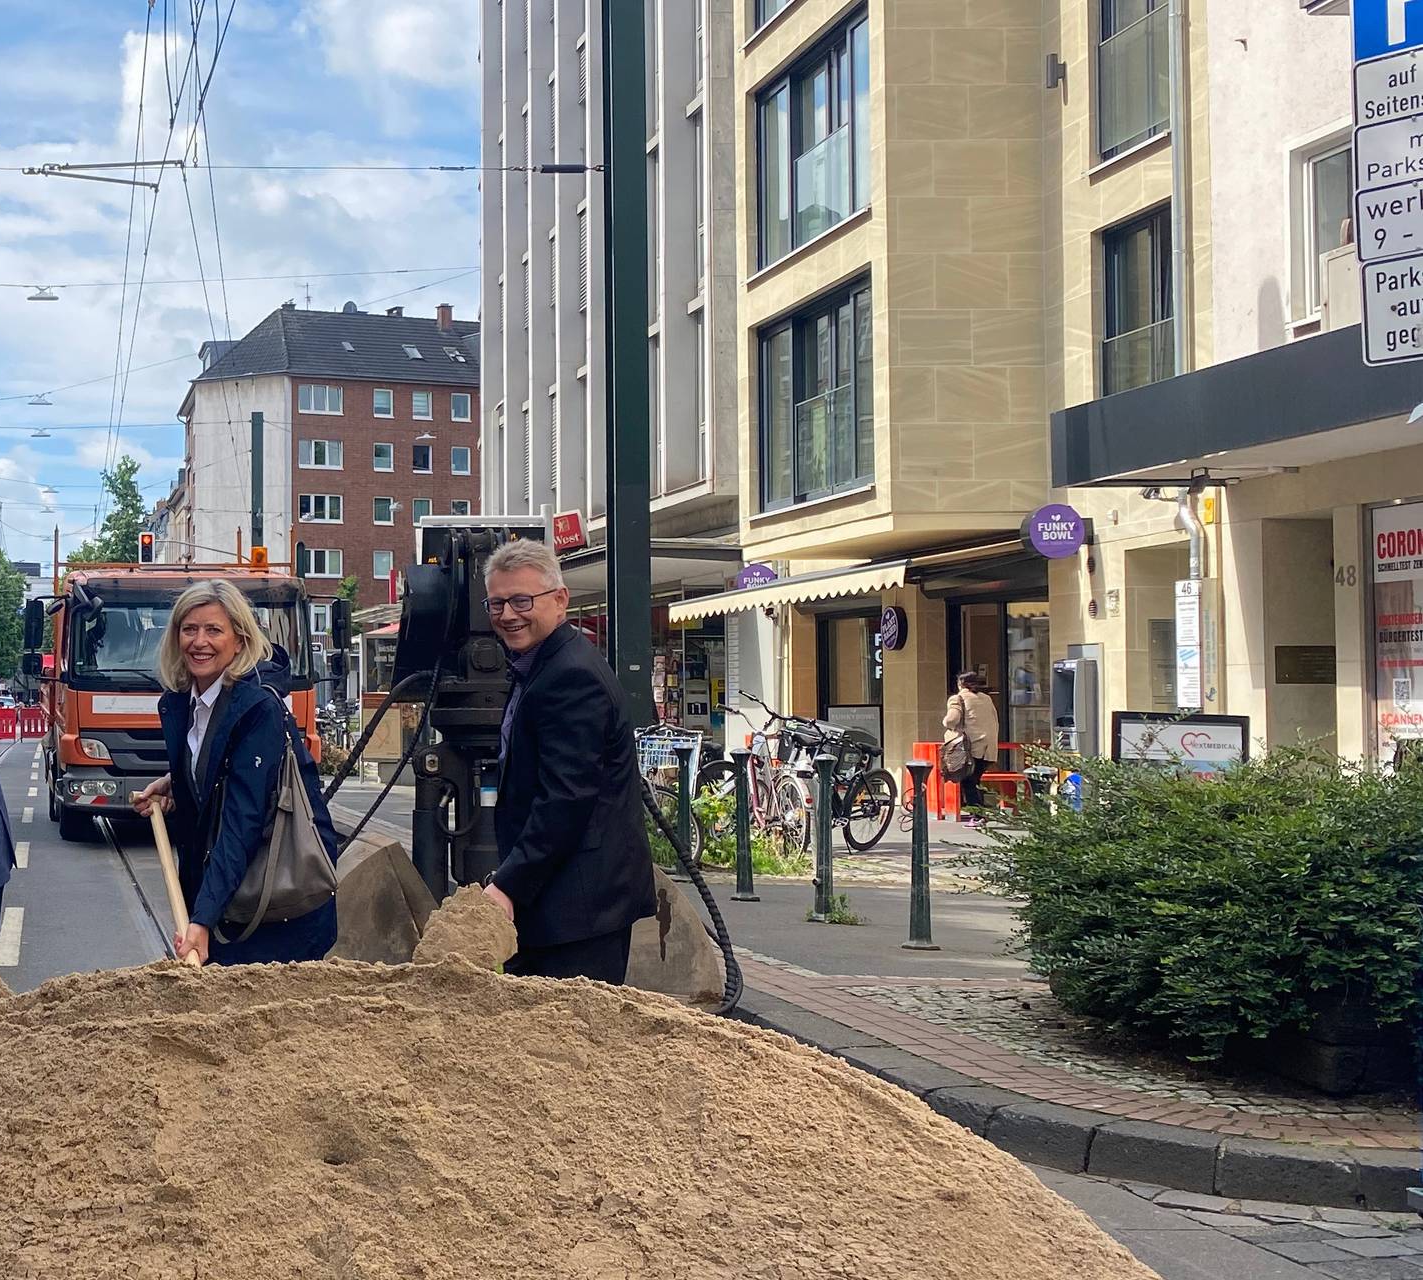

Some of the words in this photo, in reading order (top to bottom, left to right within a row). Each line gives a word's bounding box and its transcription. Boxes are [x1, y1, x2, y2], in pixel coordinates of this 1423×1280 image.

[1388, 63, 1417, 88] auf
[1365, 96, 1423, 119] Seiten
[1374, 228, 1387, 249] 9
[1376, 266, 1423, 293] Park
[1397, 298, 1423, 317] au
[1037, 522, 1076, 532] FUNKY
[1042, 531, 1074, 540] BOWL
[554, 533, 580, 545] West
[1335, 565, 1357, 587] 48
[1181, 583, 1192, 594] 46
